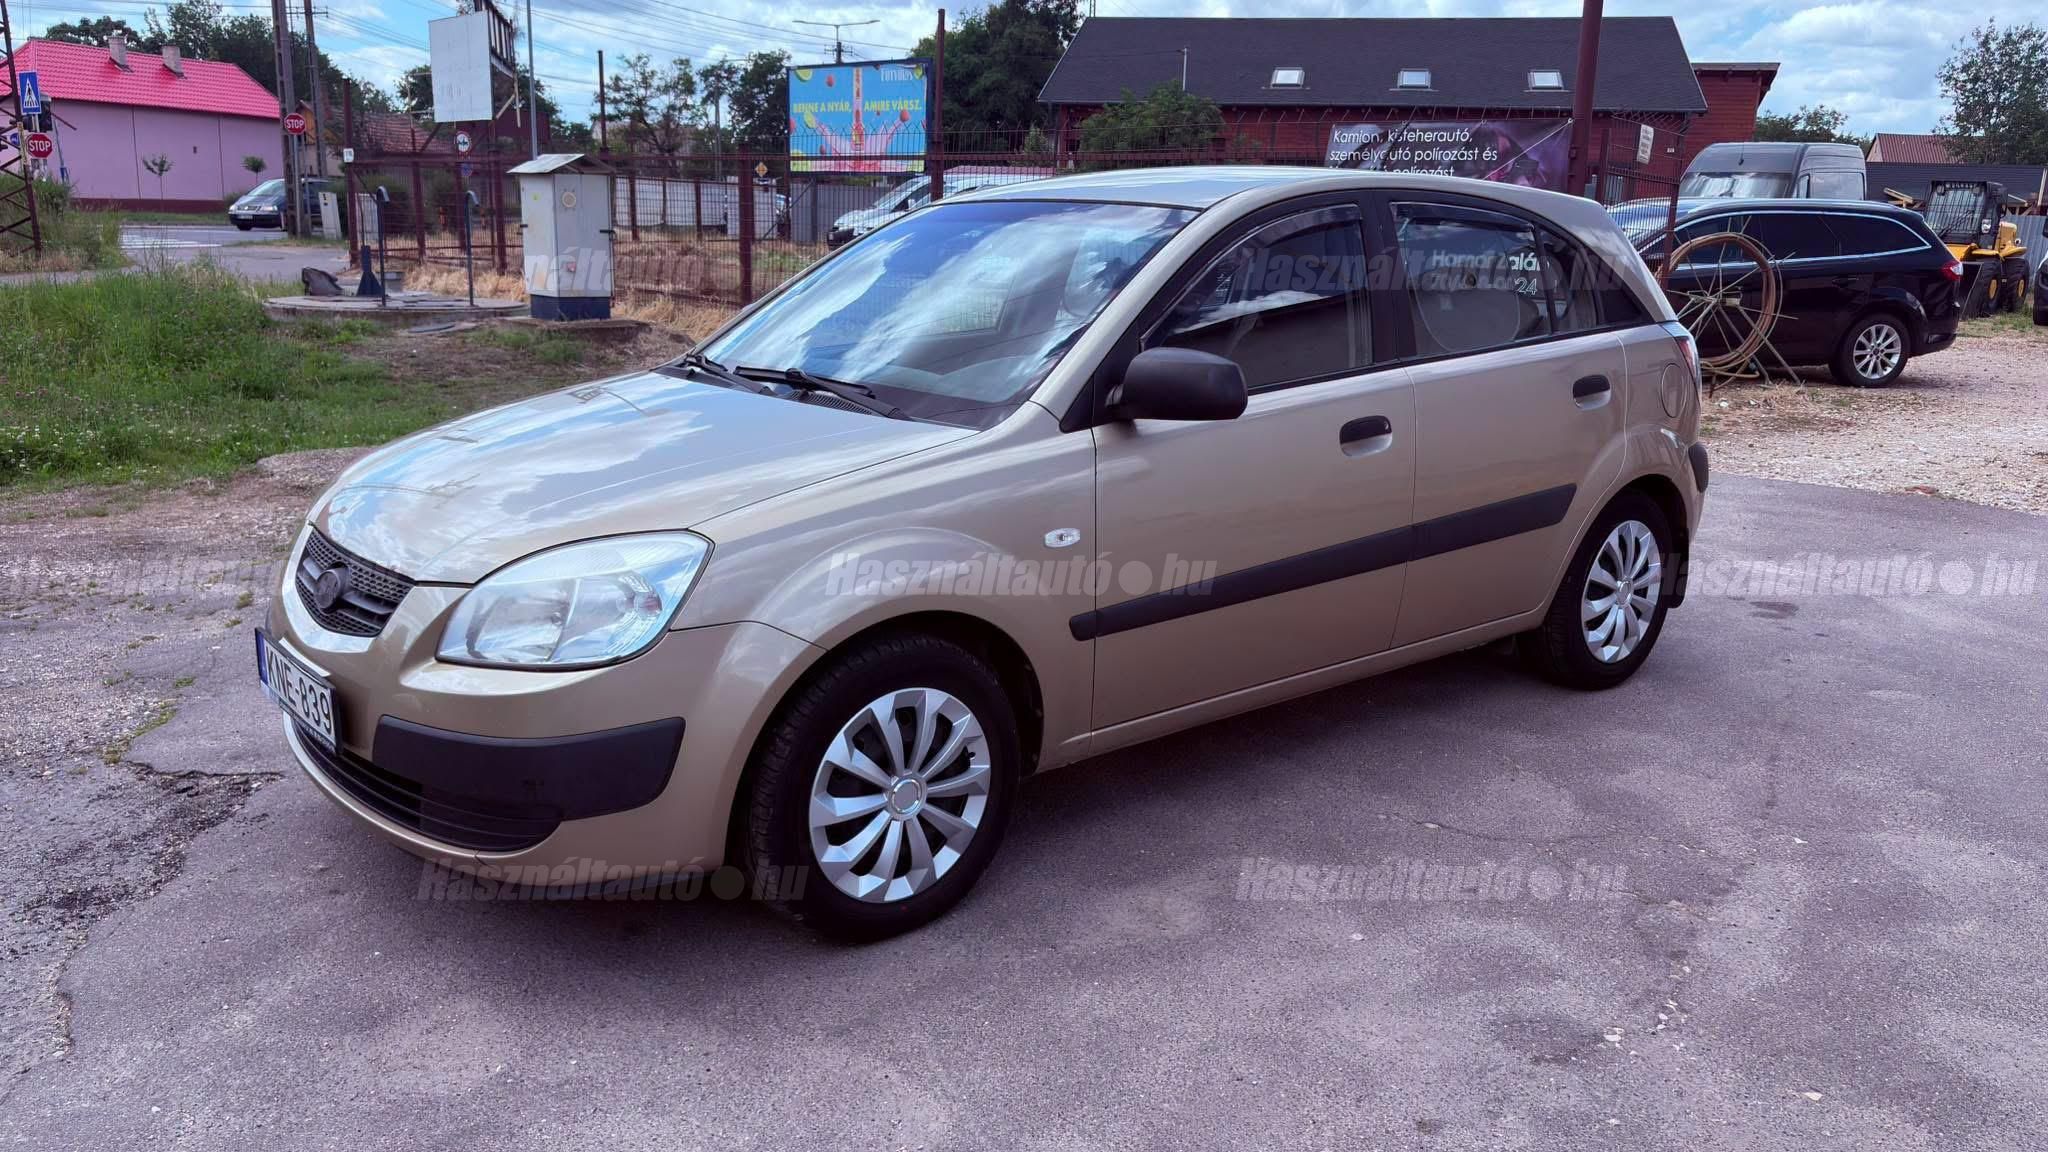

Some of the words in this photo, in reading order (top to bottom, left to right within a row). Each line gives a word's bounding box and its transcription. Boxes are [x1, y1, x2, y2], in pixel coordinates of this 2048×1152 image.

[286, 119, 305, 129] STOP
[1333, 130, 1384, 144] Kamion,
[28, 139, 52, 152] STOP
[1414, 147, 1479, 163] polírozást
[1482, 149, 1498, 161] és
[266, 646, 332, 736] KNE-839
